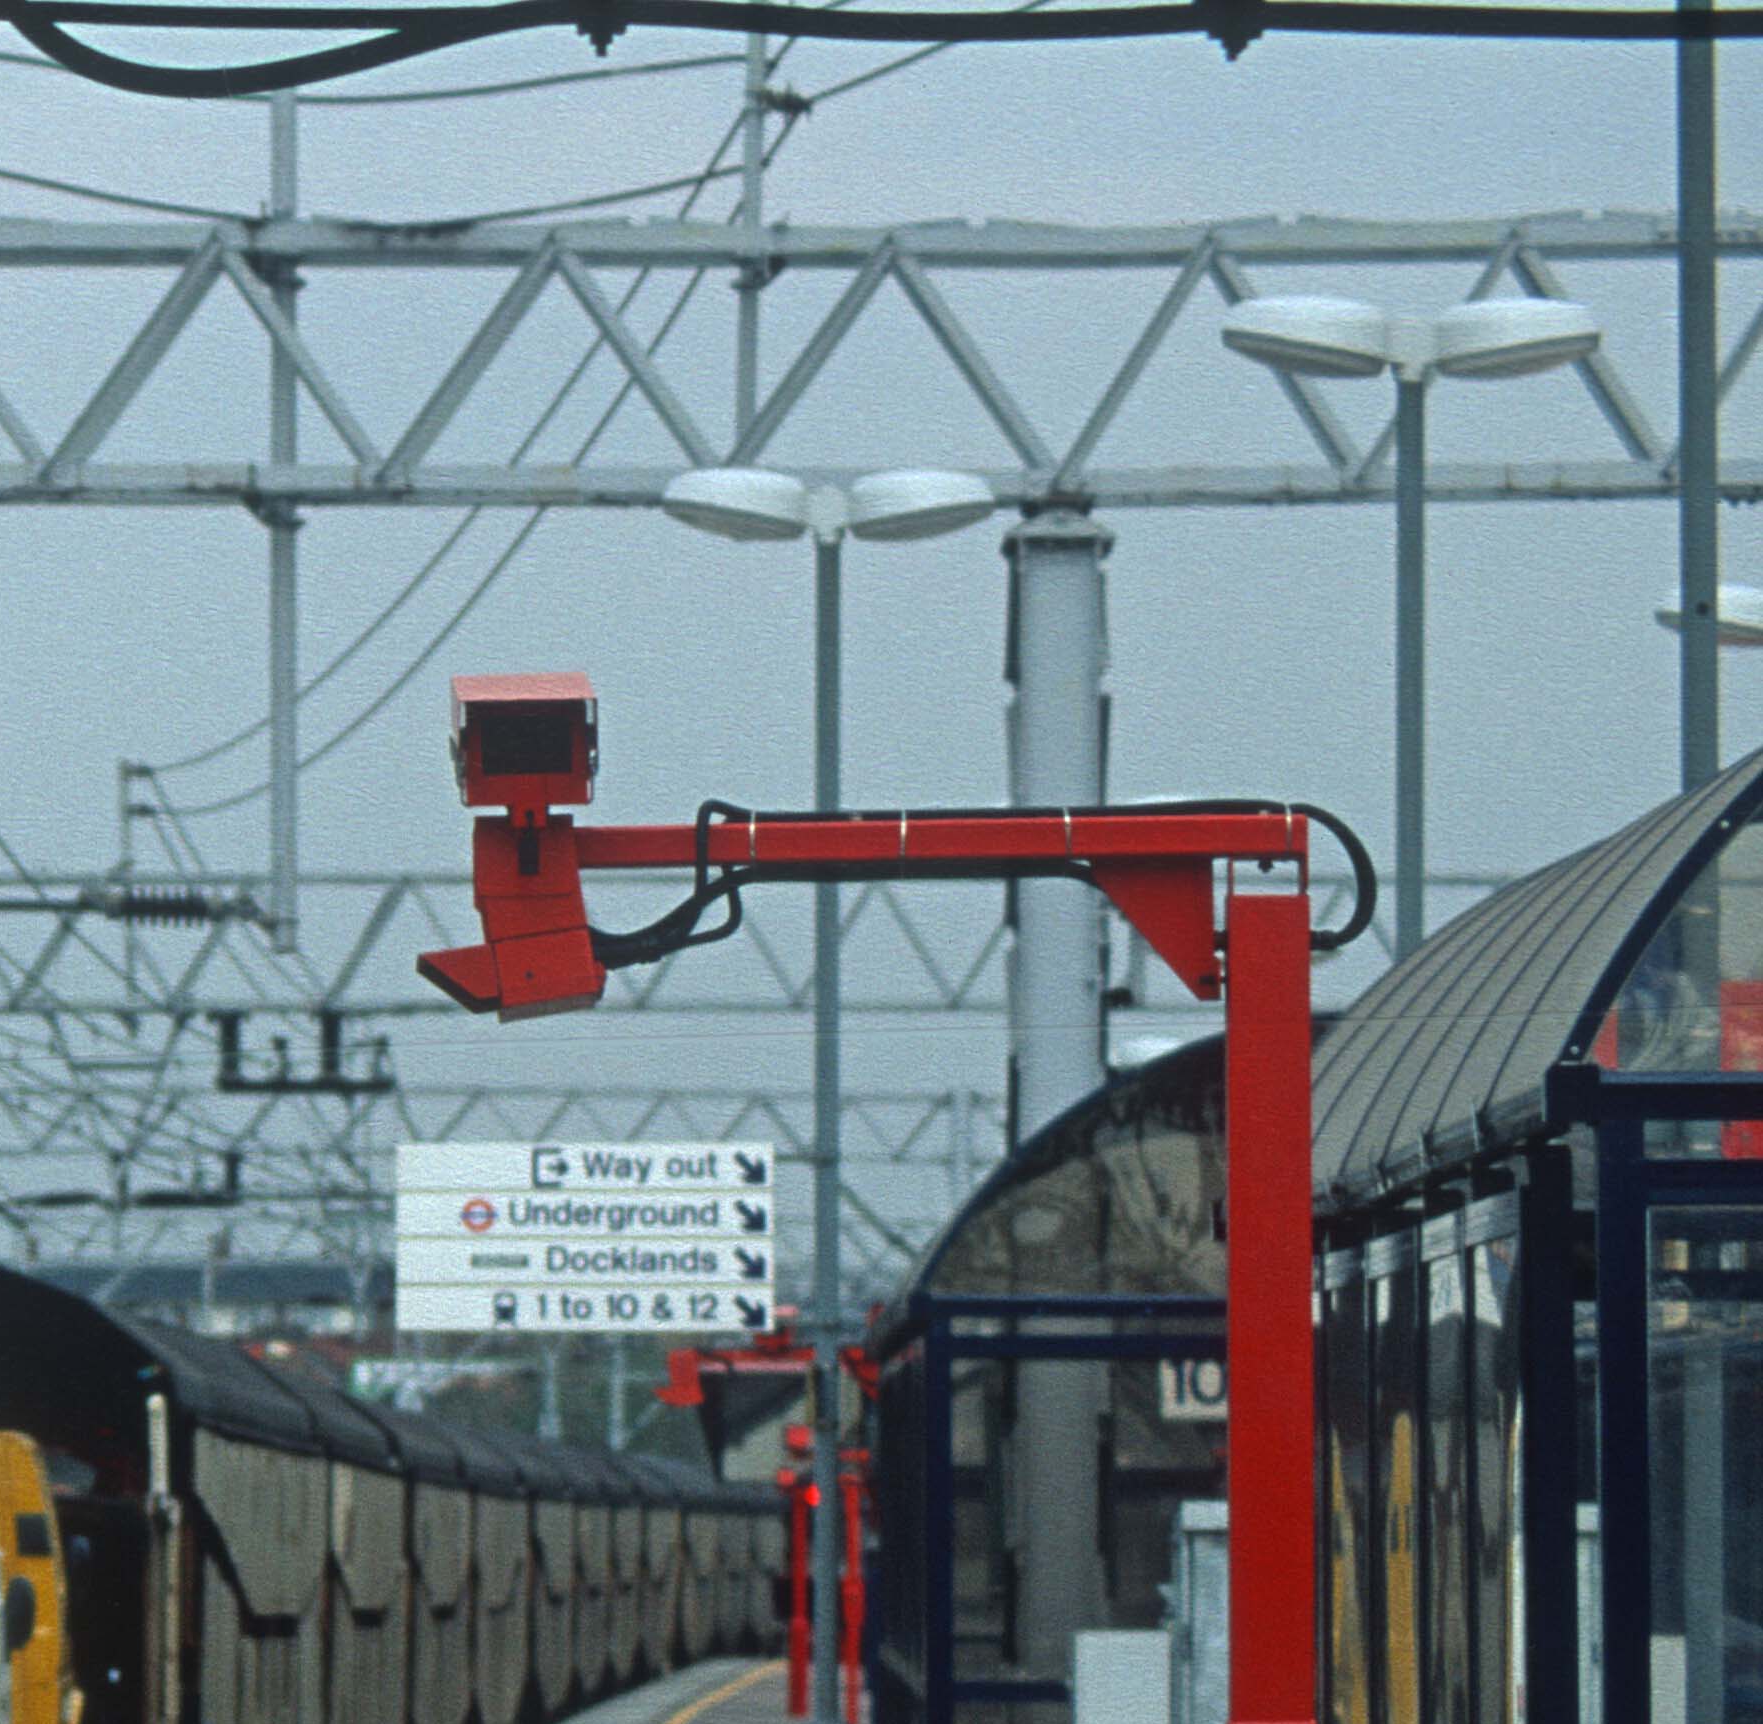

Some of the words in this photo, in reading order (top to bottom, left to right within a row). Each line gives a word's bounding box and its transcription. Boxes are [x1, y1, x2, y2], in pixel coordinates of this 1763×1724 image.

[582, 1152, 652, 1184] Way
[666, 1153, 718, 1179] out
[508, 1199, 719, 1231] Underground
[546, 1245, 718, 1274] Docklands
[537, 1293, 547, 1320] 1
[560, 1293, 593, 1321] to
[606, 1294, 640, 1321] 10
[651, 1294, 674, 1321] &
[688, 1294, 719, 1321] 12
